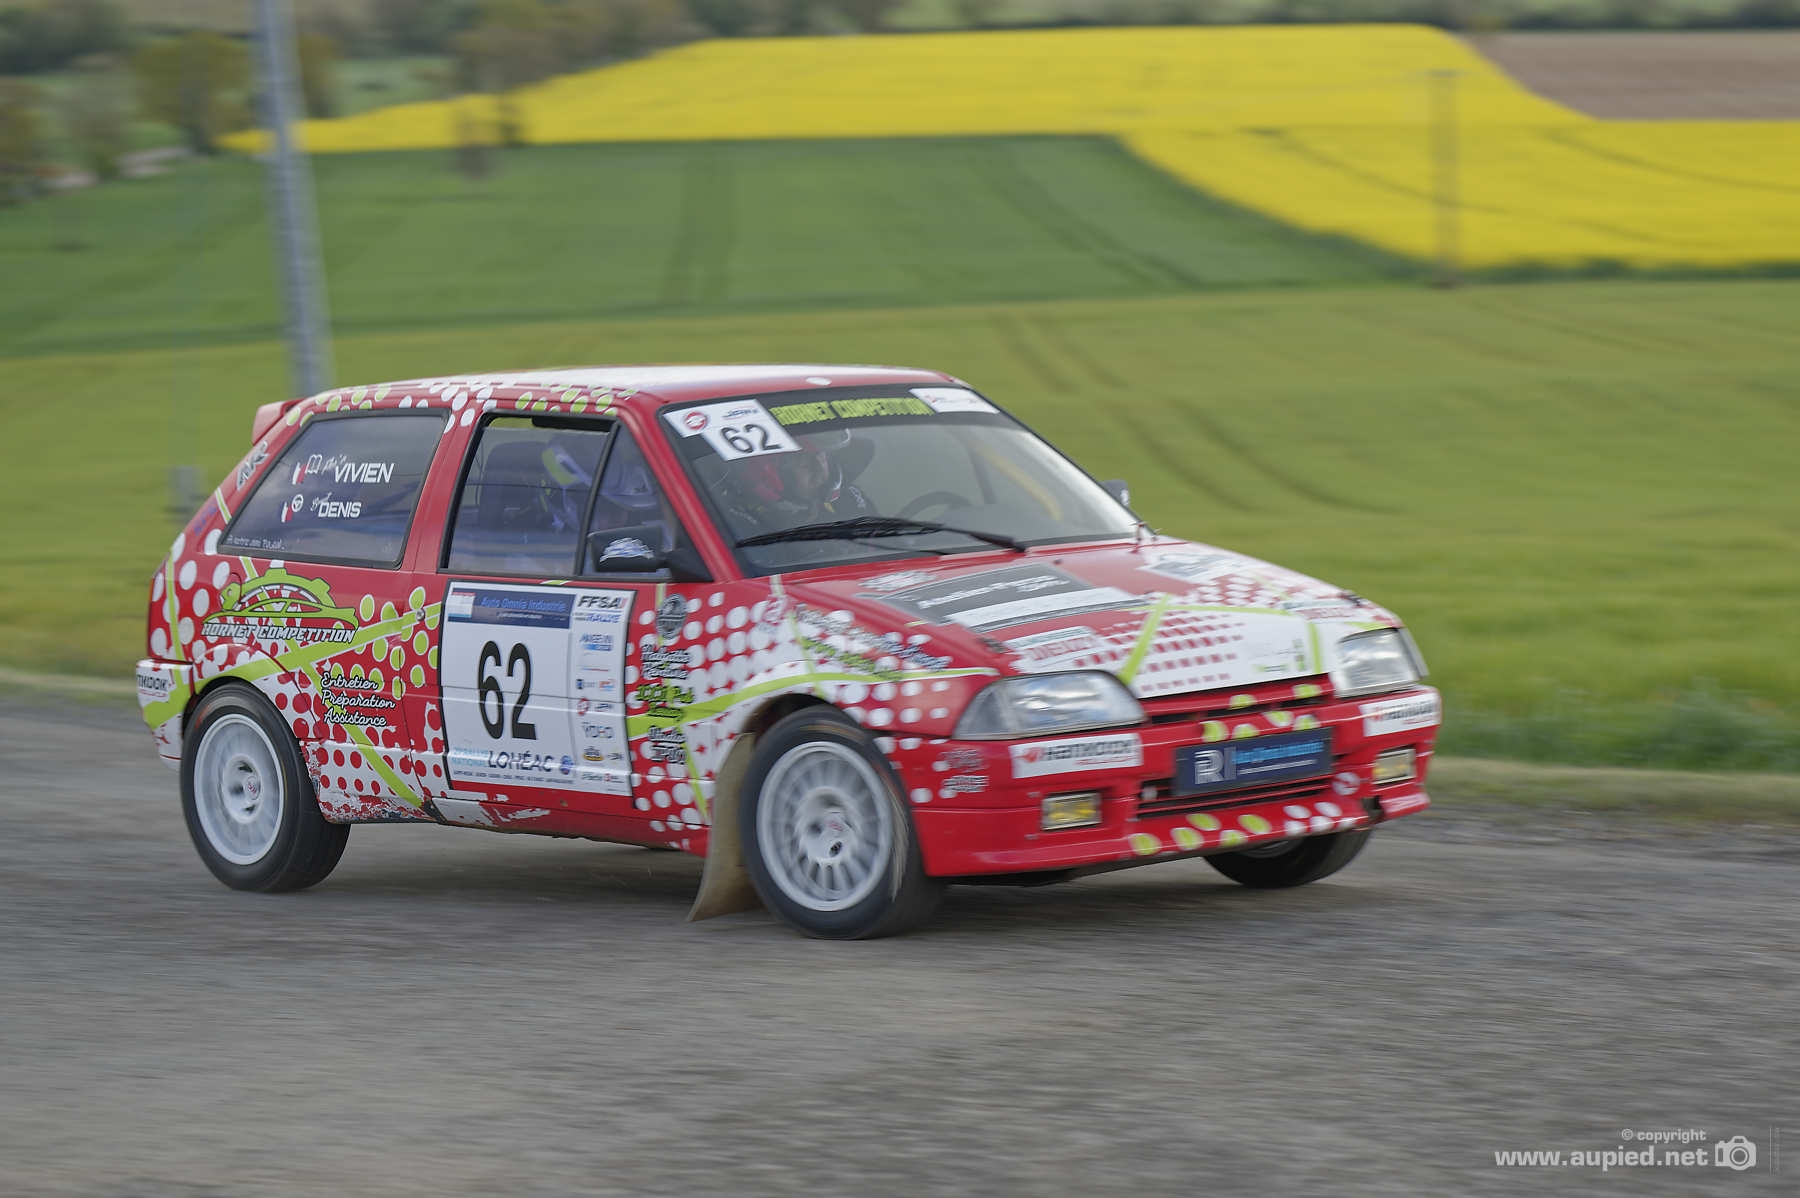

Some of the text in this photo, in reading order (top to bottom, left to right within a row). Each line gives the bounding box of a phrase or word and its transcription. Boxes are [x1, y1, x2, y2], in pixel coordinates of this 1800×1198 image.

[721, 423, 781, 453] 62
[335, 462, 394, 484] VIVIEN
[317, 501, 362, 518] DENIS
[577, 595, 621, 609] FFSA
[201, 623, 357, 644] HORNET COMPETITION
[320, 671, 379, 691] Entretien
[478, 640, 537, 740] 62
[320, 689, 396, 709] Préparation
[323, 708, 387, 727] Assistance
[487, 749, 554, 772] LOHÉAC
